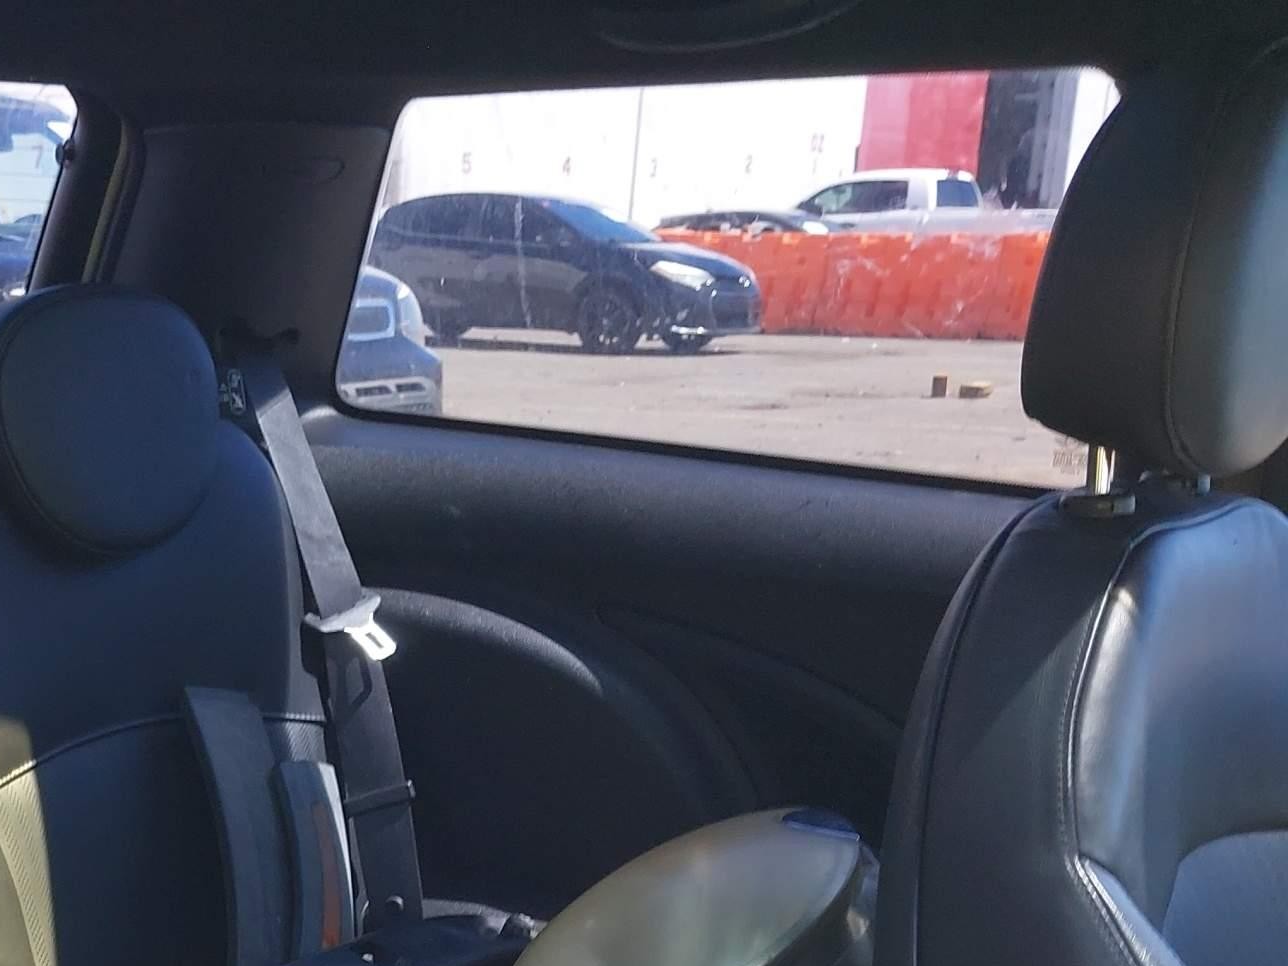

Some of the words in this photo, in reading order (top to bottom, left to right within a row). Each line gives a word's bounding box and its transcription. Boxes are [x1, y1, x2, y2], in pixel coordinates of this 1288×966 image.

[461, 151, 472, 174] 5
[561, 155, 571, 176] 4
[744, 154, 753, 175] 2
